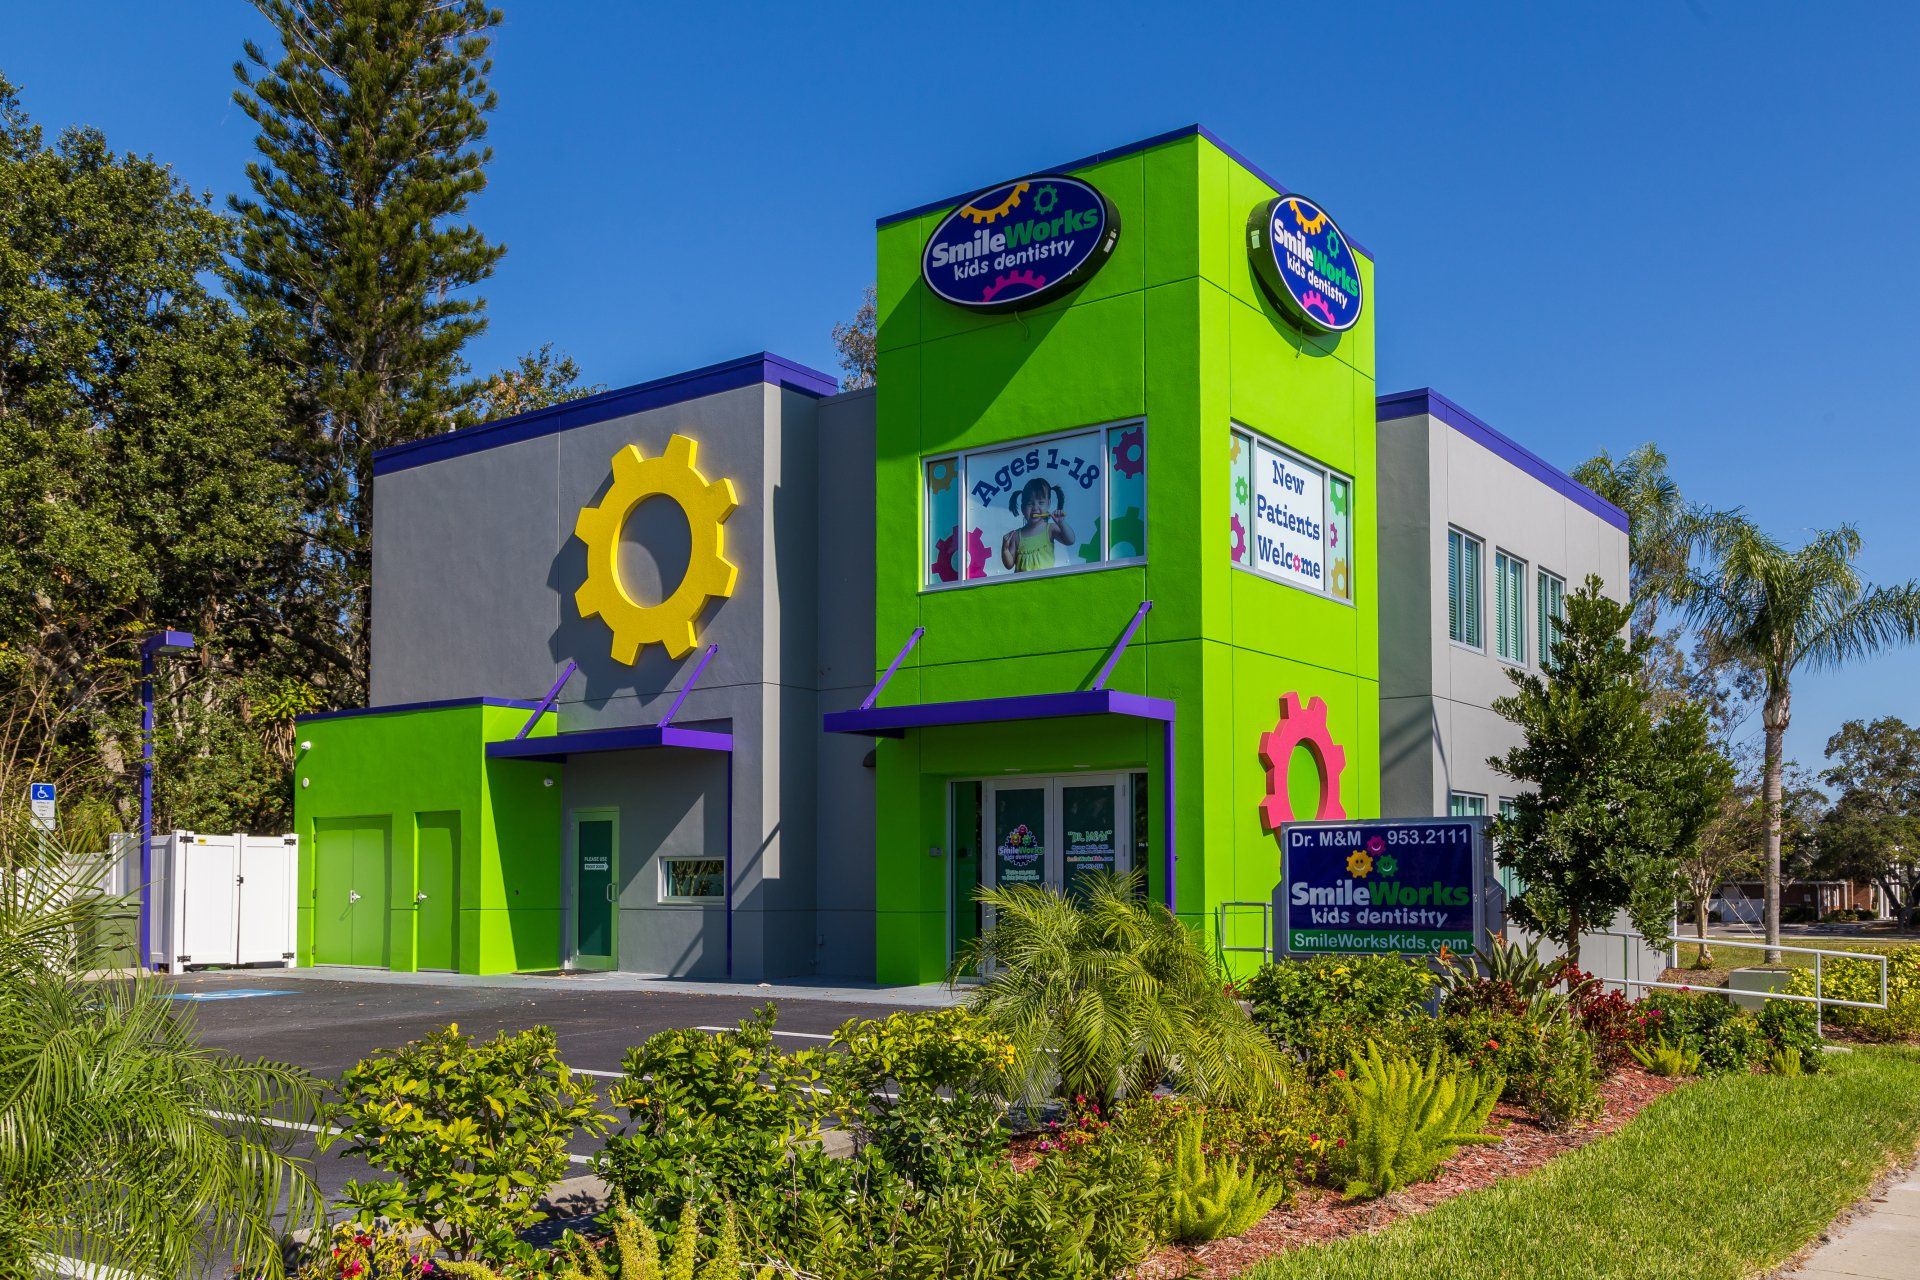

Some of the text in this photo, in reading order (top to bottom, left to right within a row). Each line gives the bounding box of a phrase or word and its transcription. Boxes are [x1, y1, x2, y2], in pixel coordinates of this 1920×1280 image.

[932, 208, 1099, 268] SmileWorks
[1274, 218, 1359, 297] SmileWorks
[953, 239, 1075, 281] kids dentistry
[1286, 252, 1348, 310] kids dentistry
[971, 448, 1100, 508] Ages 1-18
[1272, 460, 1305, 495] New
[1257, 494, 1320, 541] Patients
[1258, 534, 1320, 579] Welcome
[1292, 828, 1467, 847] Dr. M&M 953.2111
[1291, 879, 1470, 906] SmileWorks
[1311, 907, 1448, 928] kids dentistry
[1294, 933, 1468, 950] SmileWorksKids.com
